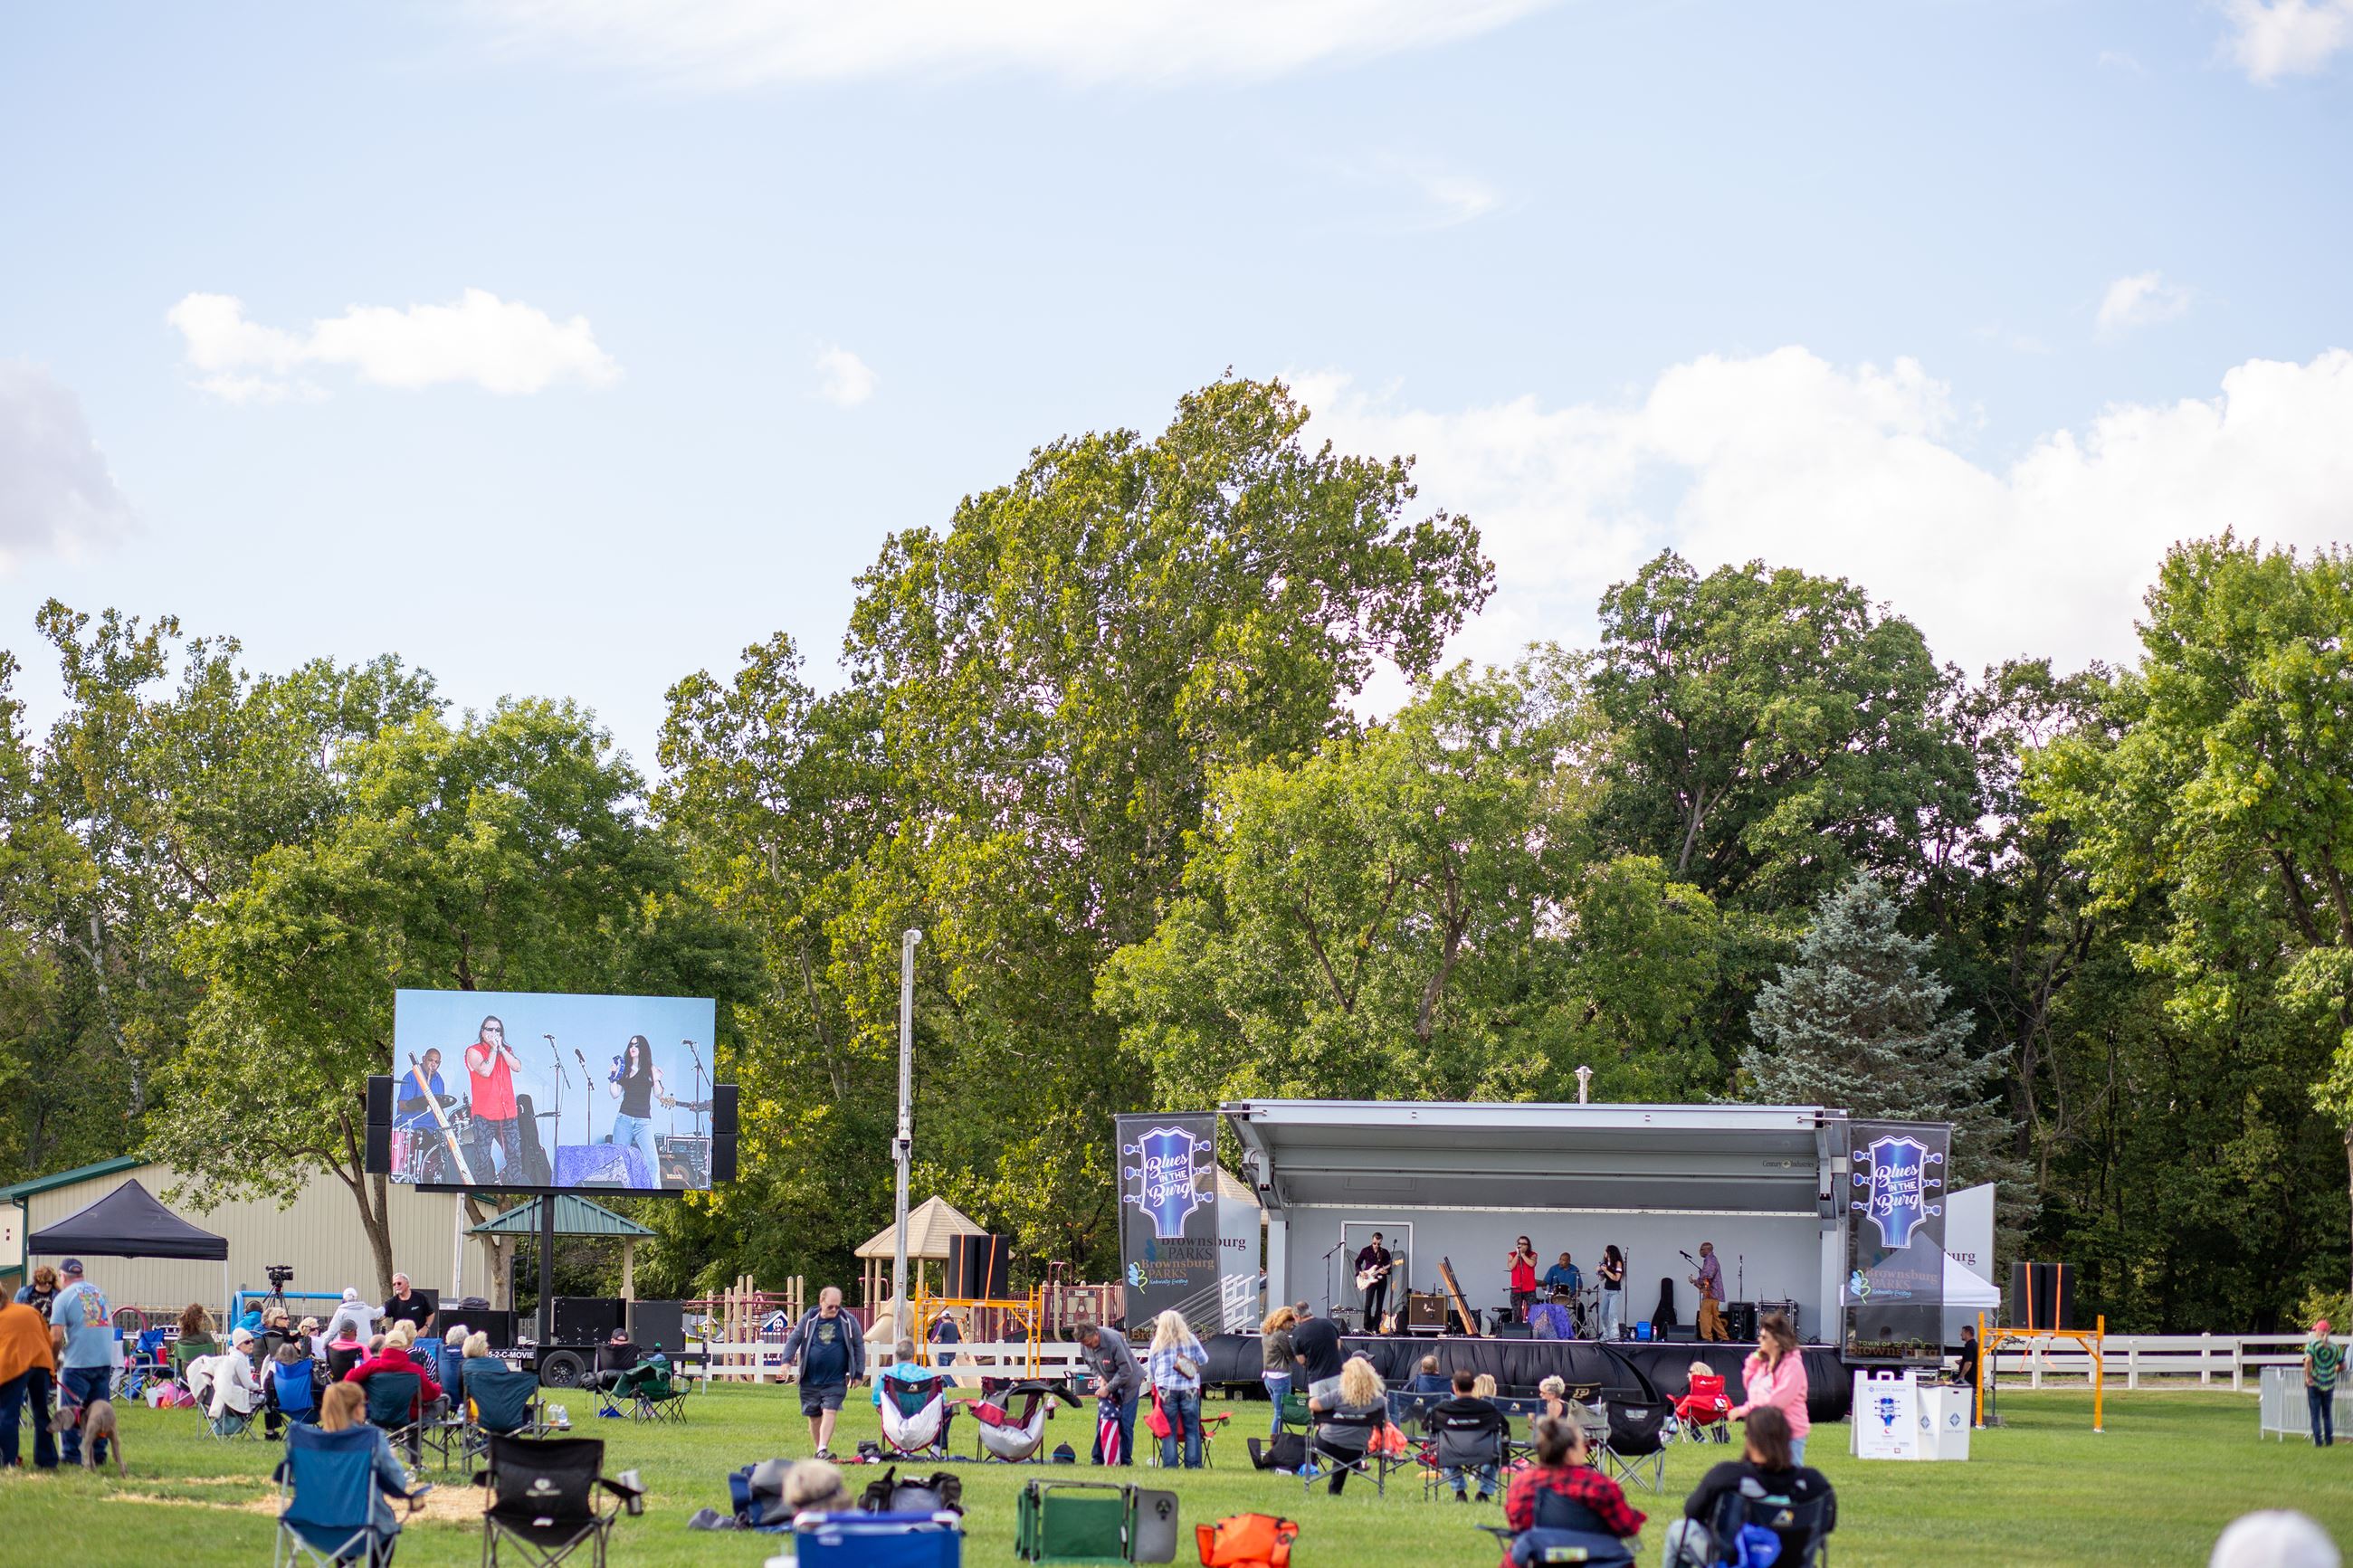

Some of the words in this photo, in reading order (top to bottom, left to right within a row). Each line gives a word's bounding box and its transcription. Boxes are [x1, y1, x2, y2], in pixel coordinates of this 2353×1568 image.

[1146, 1154, 1189, 1180] Blues
[1158, 1174, 1168, 1183] IN
[1168, 1170, 1187, 1181] THE
[1875, 1163, 1920, 1188] Blues
[1887, 1183, 1898, 1193] IN
[1898, 1181, 1917, 1191] THE
[1167, 1247, 1214, 1259] PARKS
[1141, 1259, 1215, 1270] Brownsburg
[1148, 1269, 1187, 1278] PARKS
[1864, 1268, 1938, 1285] Brownsburg
[1871, 1278, 1912, 1291] PARKS
